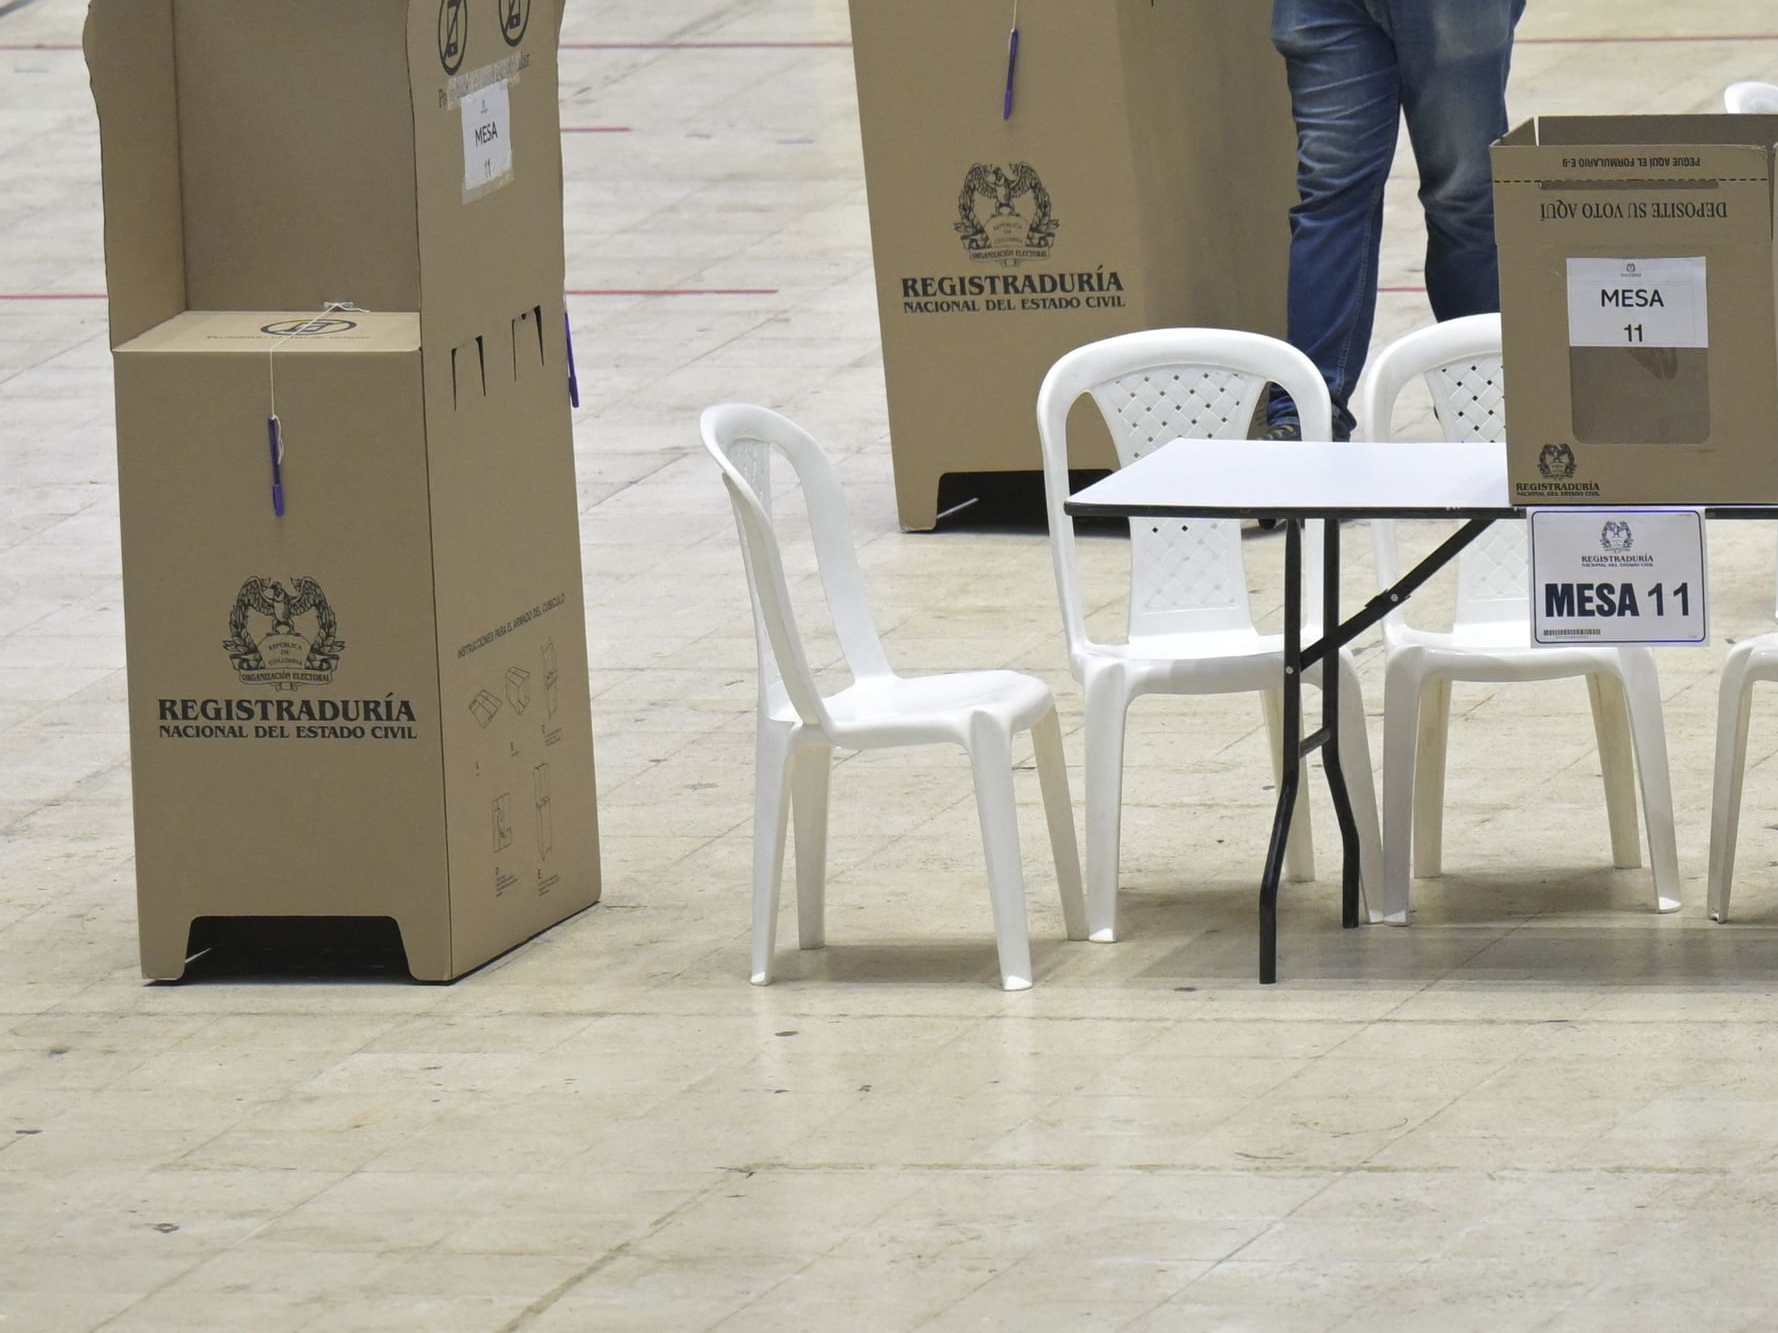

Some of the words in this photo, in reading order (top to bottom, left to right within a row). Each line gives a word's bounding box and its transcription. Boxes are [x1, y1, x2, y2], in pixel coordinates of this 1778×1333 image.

[475, 121, 499, 148] MESA
[1578, 157, 1635, 168] FORMULARIO
[1636, 157, 1648, 167] EL
[1672, 156, 1701, 167] PEGUE
[1540, 199, 1578, 222] AQUÍ
[1582, 202, 1626, 218] VOTO
[1627, 202, 1647, 218] SU
[1651, 201, 1728, 218] DEPOSITE
[901, 264, 1124, 298] REGISTRADURÍA
[903, 298, 980, 314] NACIONAL
[985, 298, 1016, 312] DEL
[1021, 296, 1081, 310] ESTADO
[1085, 295, 1126, 308] CIVIL
[1601, 289, 1664, 308] MESA
[1623, 324, 1643, 343] 11
[1515, 479, 1600, 491] REGISTRADURÍA
[1581, 553, 1654, 563] REGISTRADURÍA
[1544, 582, 1640, 618] MESA
[1647, 582, 1690, 617] 11
[158, 691, 417, 723] REGISTRADURÍA
[159, 724, 248, 739] NACIONAL
[255, 725, 290, 739] DEL
[296, 725, 366, 739] ESTADO
[371, 725, 418, 740] CIVIL
